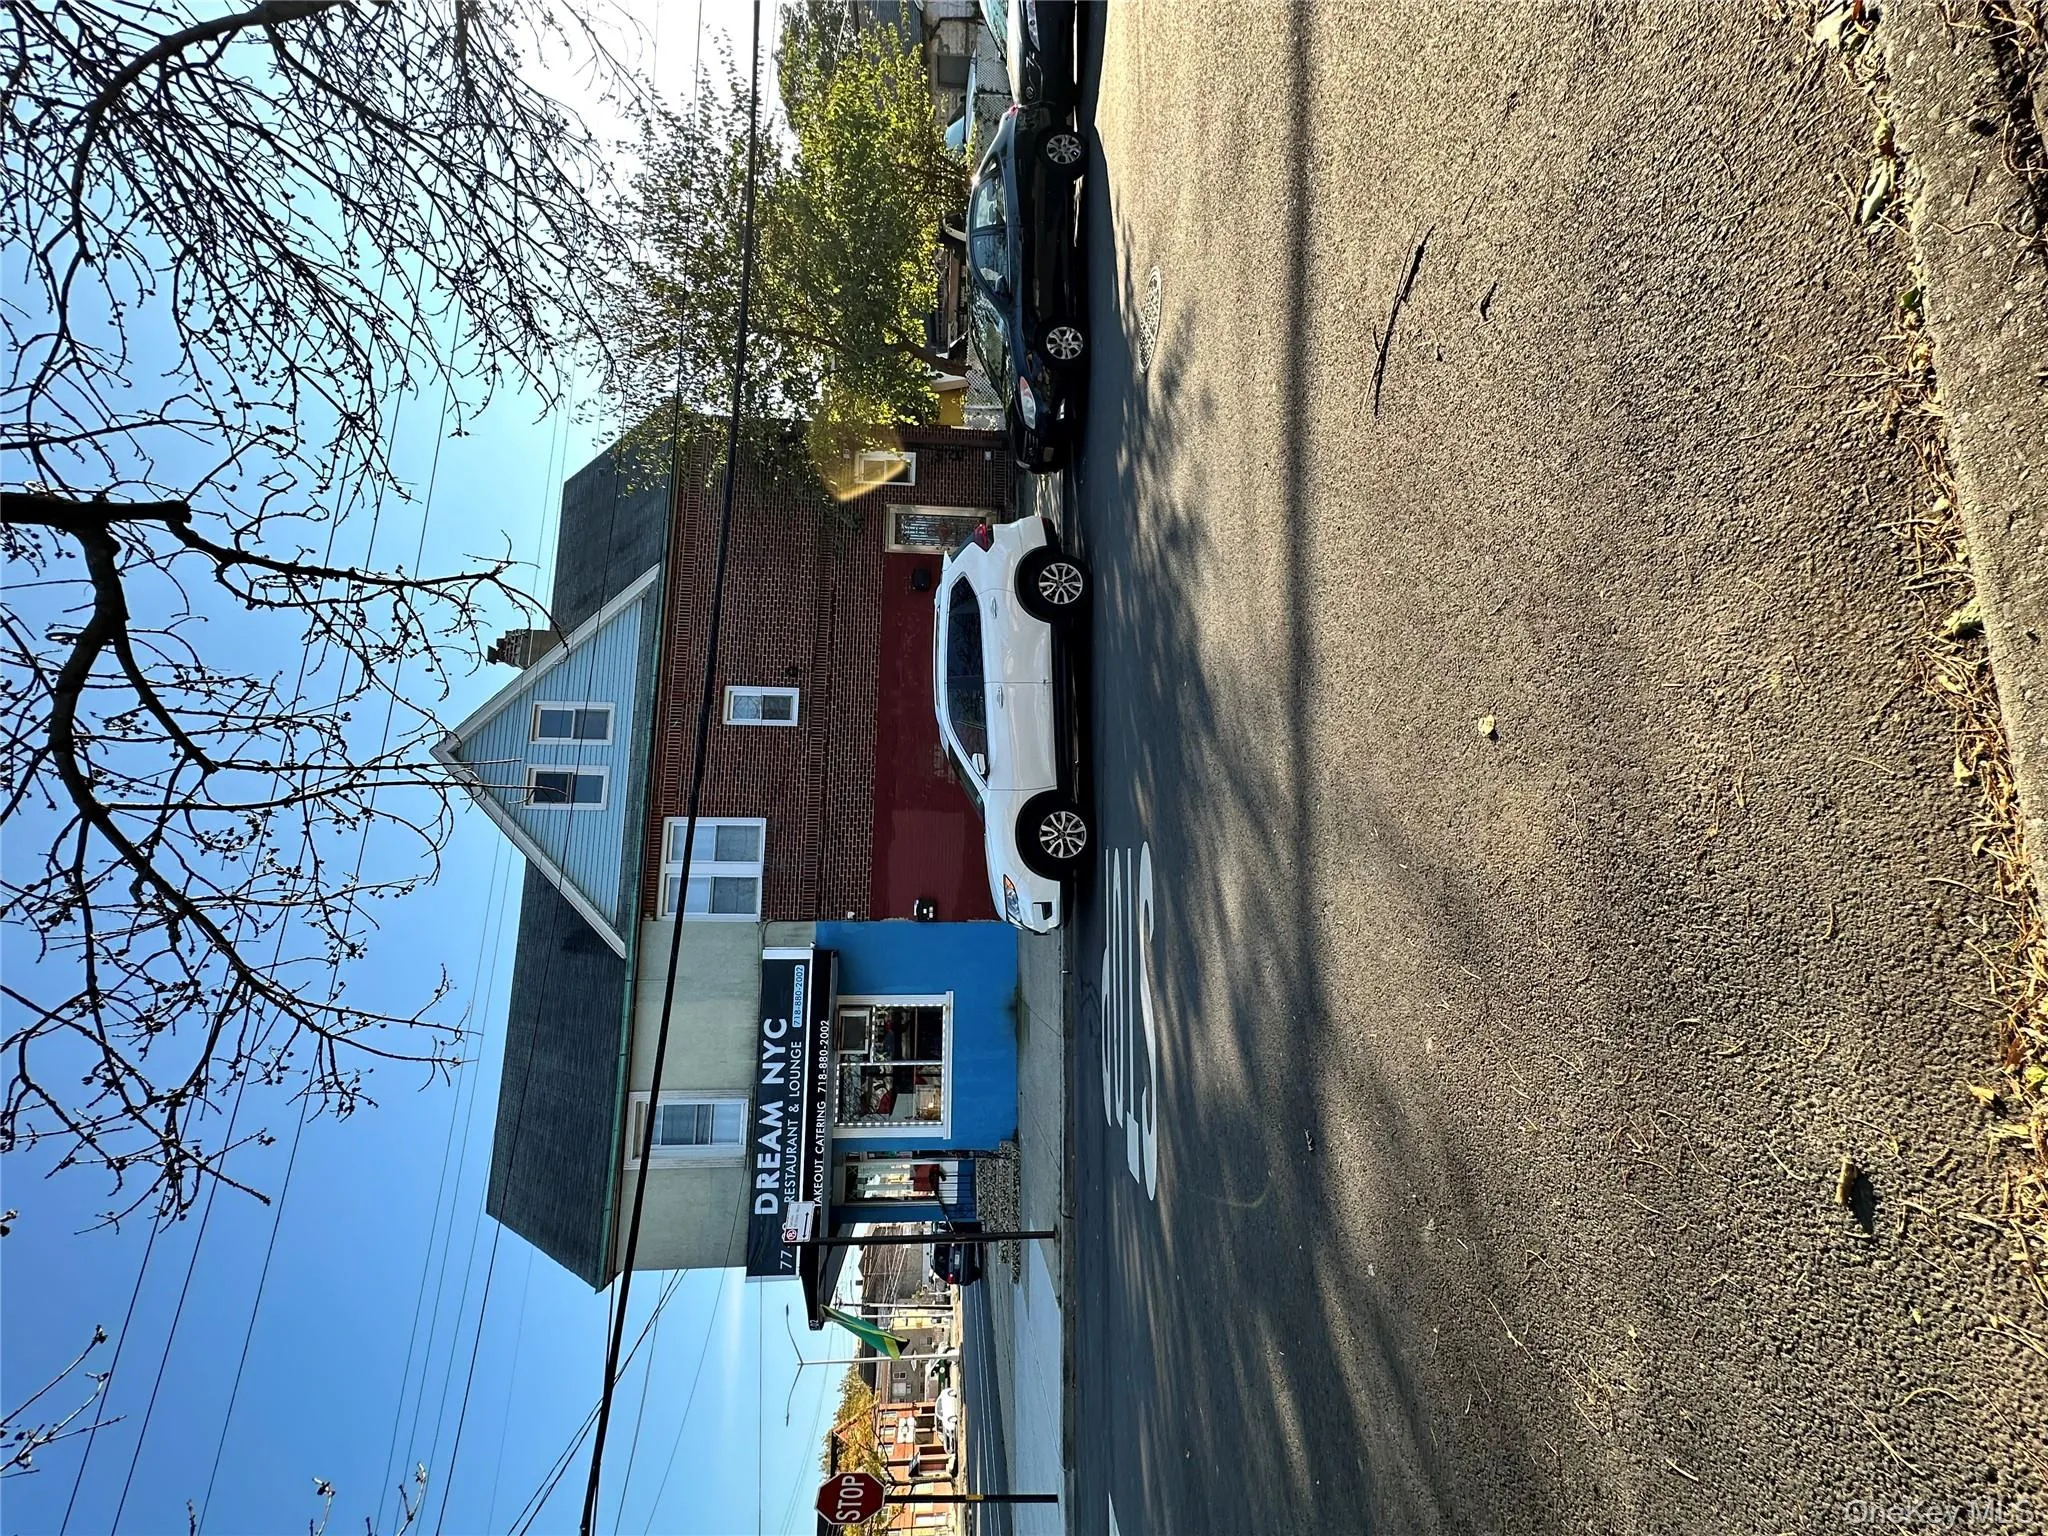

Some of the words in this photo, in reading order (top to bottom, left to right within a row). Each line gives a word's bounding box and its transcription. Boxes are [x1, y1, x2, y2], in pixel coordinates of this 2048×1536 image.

[794, 966, 804, 1025] 718-880-2002
[1102, 840, 1158, 1200] STOP
[762, 1018, 788, 1084] NYC
[788, 1042, 802, 1096] LOUNGE
[818, 1020, 829, 1093] 718-880-2002
[788, 1104, 800, 1112] &
[815, 1101, 826, 1154] CATERING
[754, 1100, 784, 1214] DREAM
[784, 1119, 798, 1202] RESTAURANT
[813, 1159, 824, 1207] TAKEOUT
[836, 1476, 864, 1520] STOP
